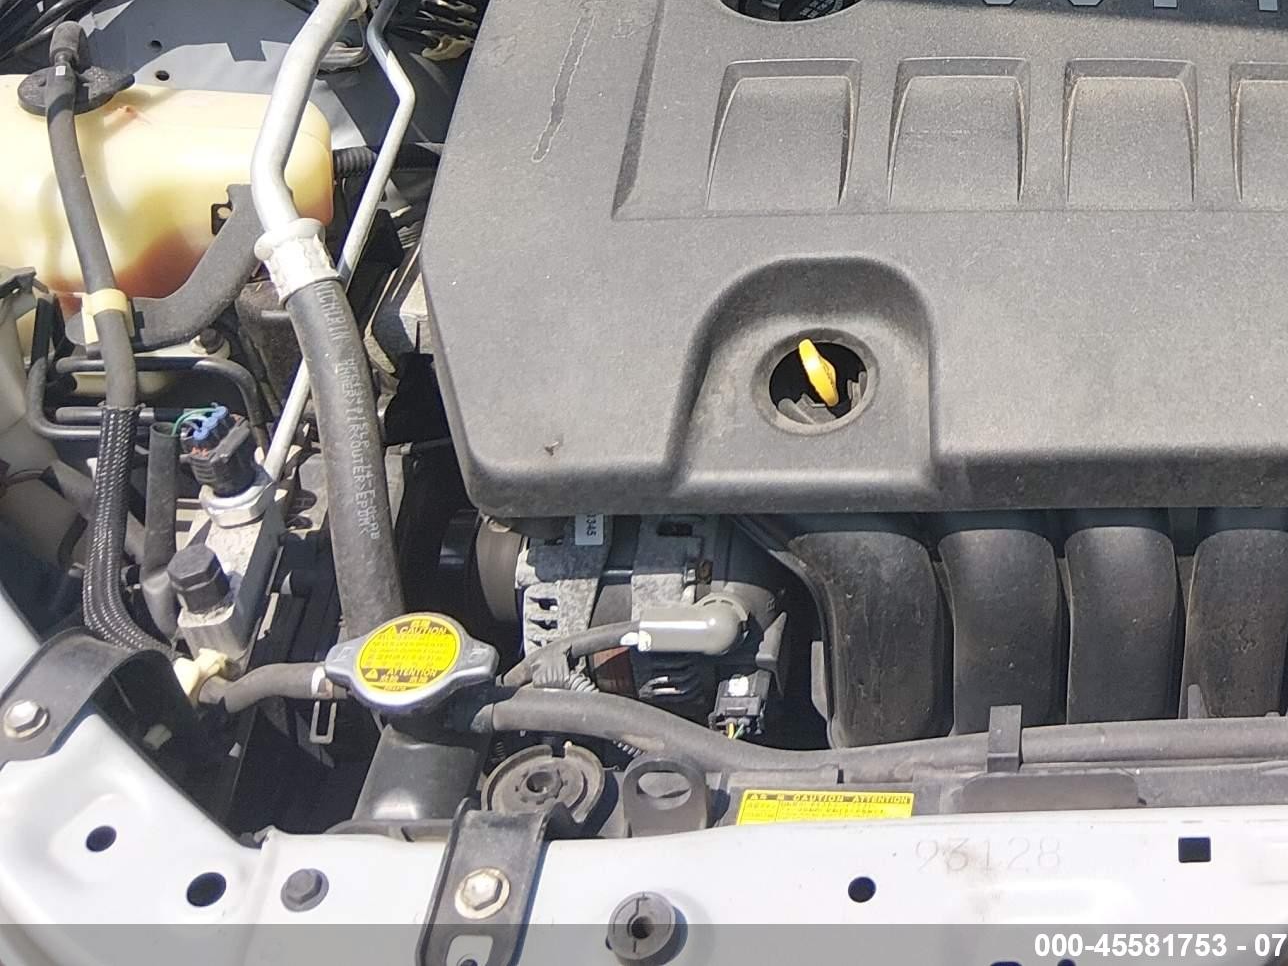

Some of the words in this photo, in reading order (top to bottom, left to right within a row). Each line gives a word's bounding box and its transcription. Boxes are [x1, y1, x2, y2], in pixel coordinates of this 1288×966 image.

[400, 626, 447, 635] CAUTION
[386, 667, 437, 677] ATTENTION
[793, 794, 844, 803] CAUTION
[852, 794, 909, 804] ATTENTION
